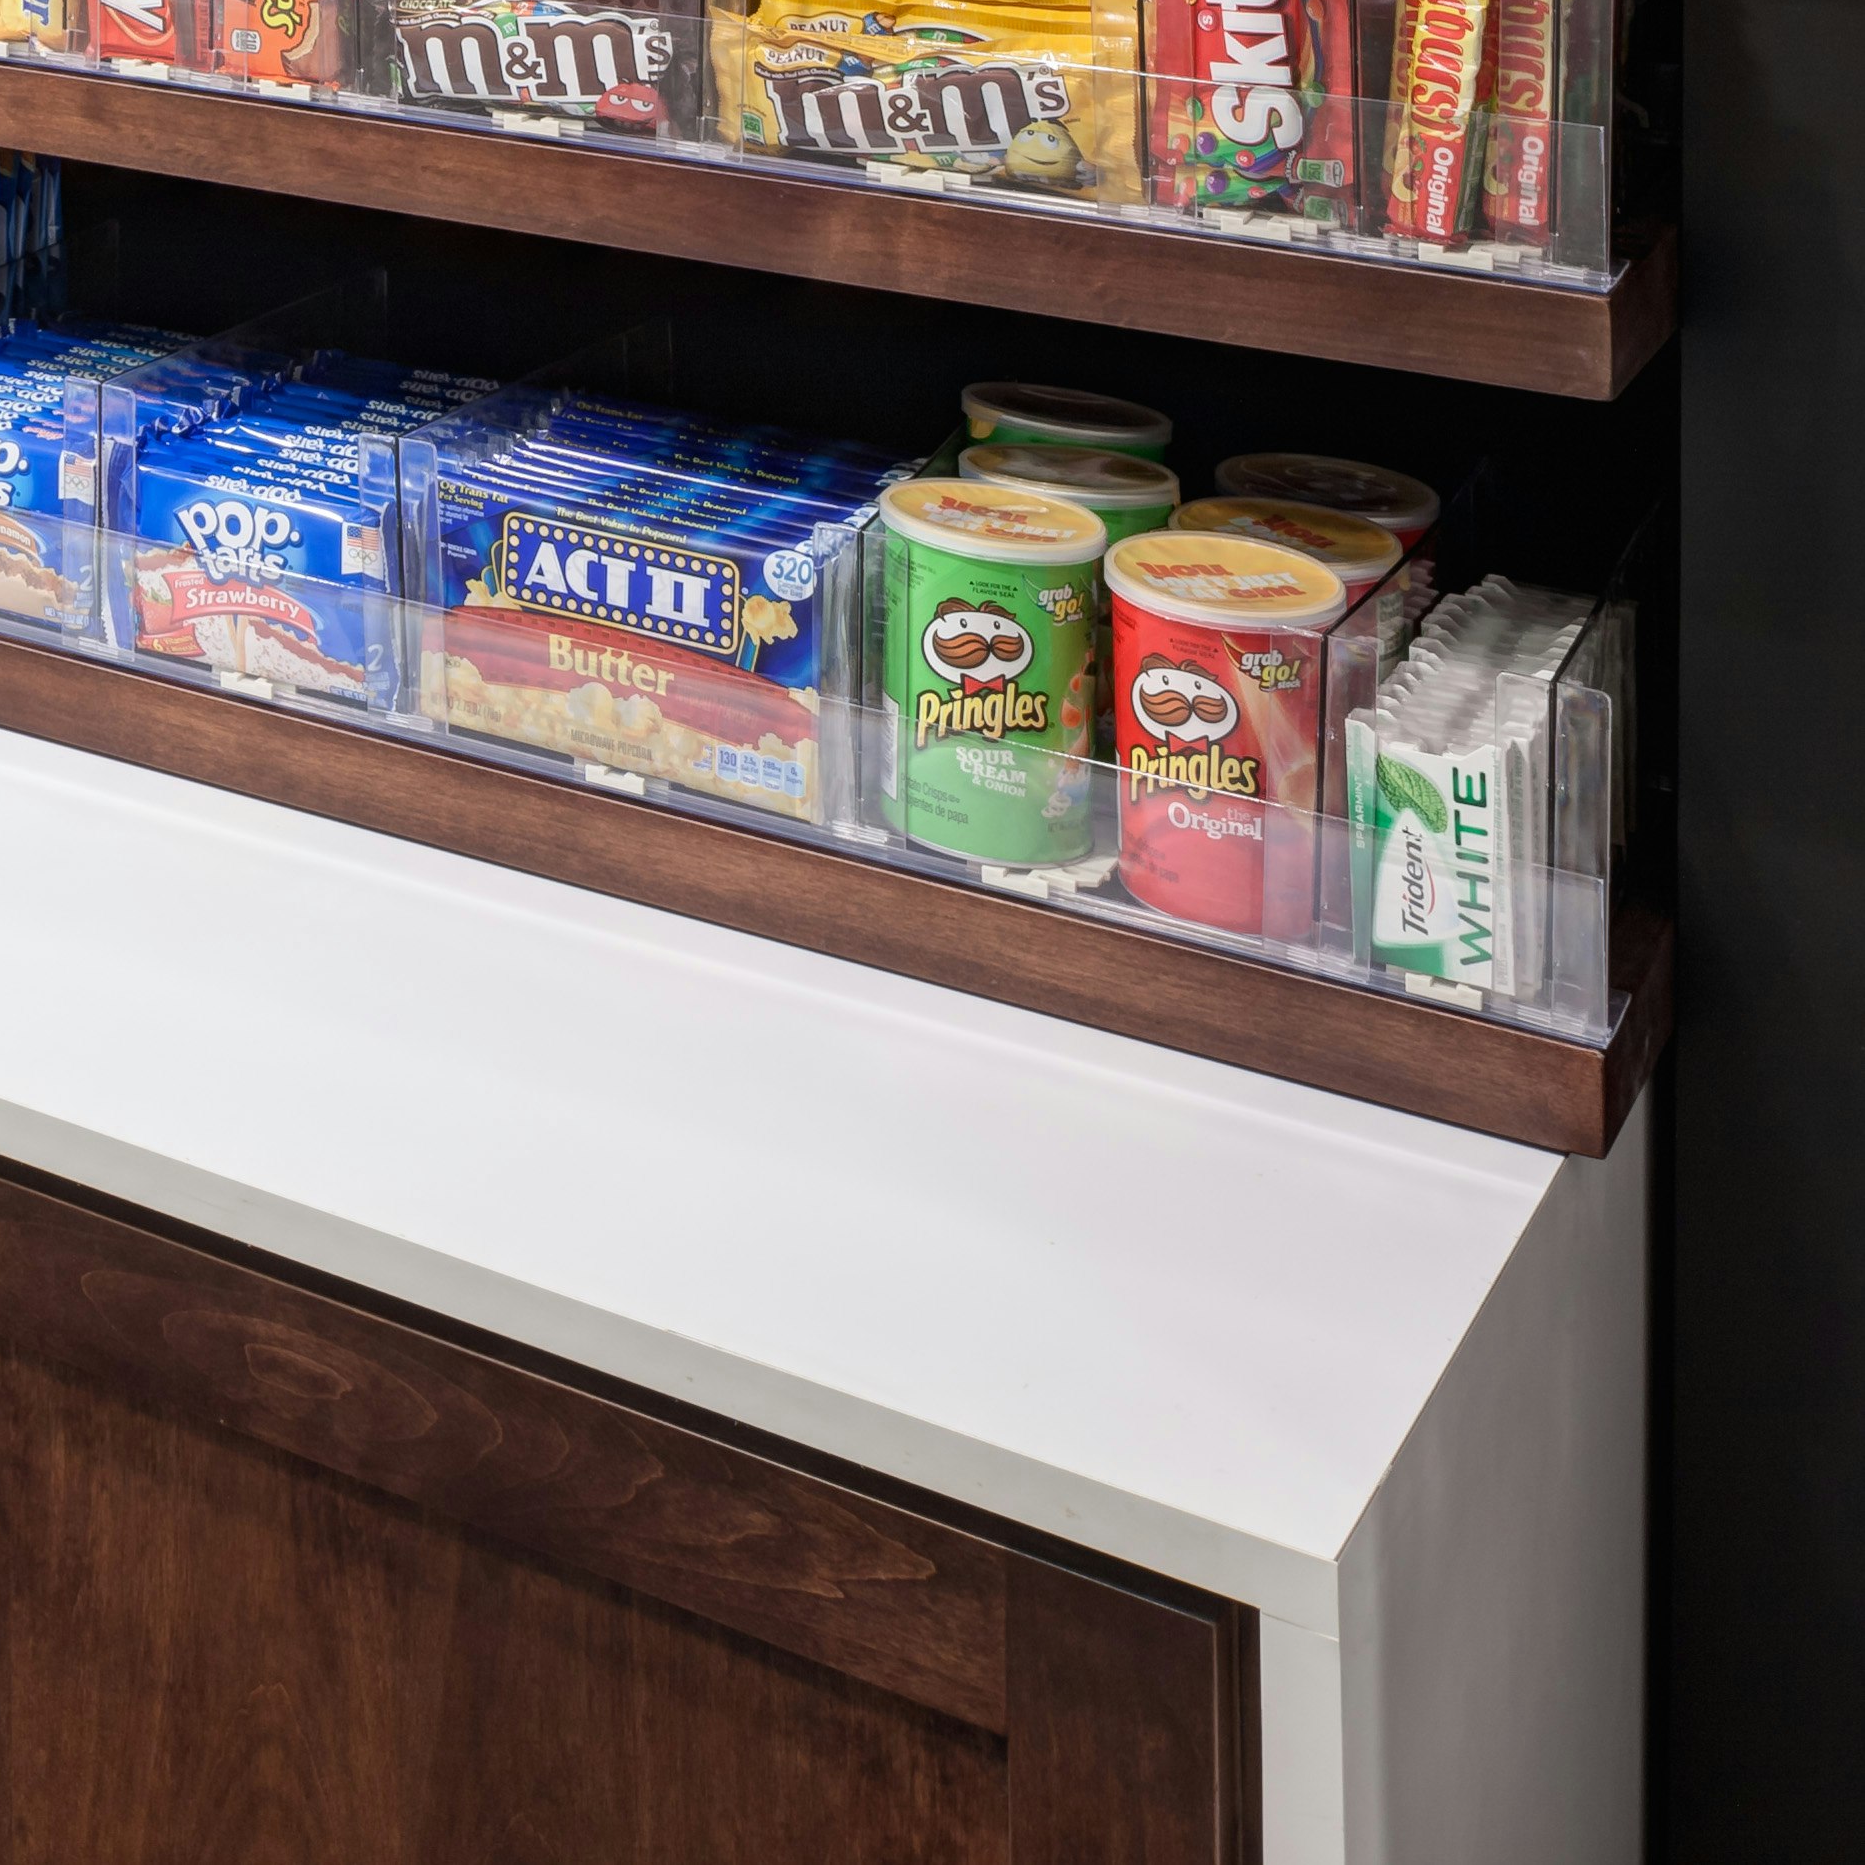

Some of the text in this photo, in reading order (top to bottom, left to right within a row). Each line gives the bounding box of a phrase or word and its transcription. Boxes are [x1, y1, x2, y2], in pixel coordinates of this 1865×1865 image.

[1425, 145, 1455, 234] Original
[556, 506, 574, 518] The
[576, 511, 598, 524] Best
[600, 516, 627, 531] Value
[641, 525, 687, 545] Popcorn!
[173, 577, 205, 590] Frosted
[523, 541, 711, 627] ACT II
[771, 555, 812, 584] 320
[186, 587, 301, 618] Strawberry
[548, 634, 675, 698] Butter
[1240, 651, 1283, 674] grab
[1261, 661, 1301, 686] go!
[915, 683, 1049, 749] Pringles
[955, 746, 1015, 767] SOUR
[959, 756, 1027, 784] CREAM
[1129, 737, 1258, 803] Pringles
[1168, 801, 1263, 840] Original
[1401, 825, 1429, 936] Trident
[1449, 765, 1493, 966] WHITE
